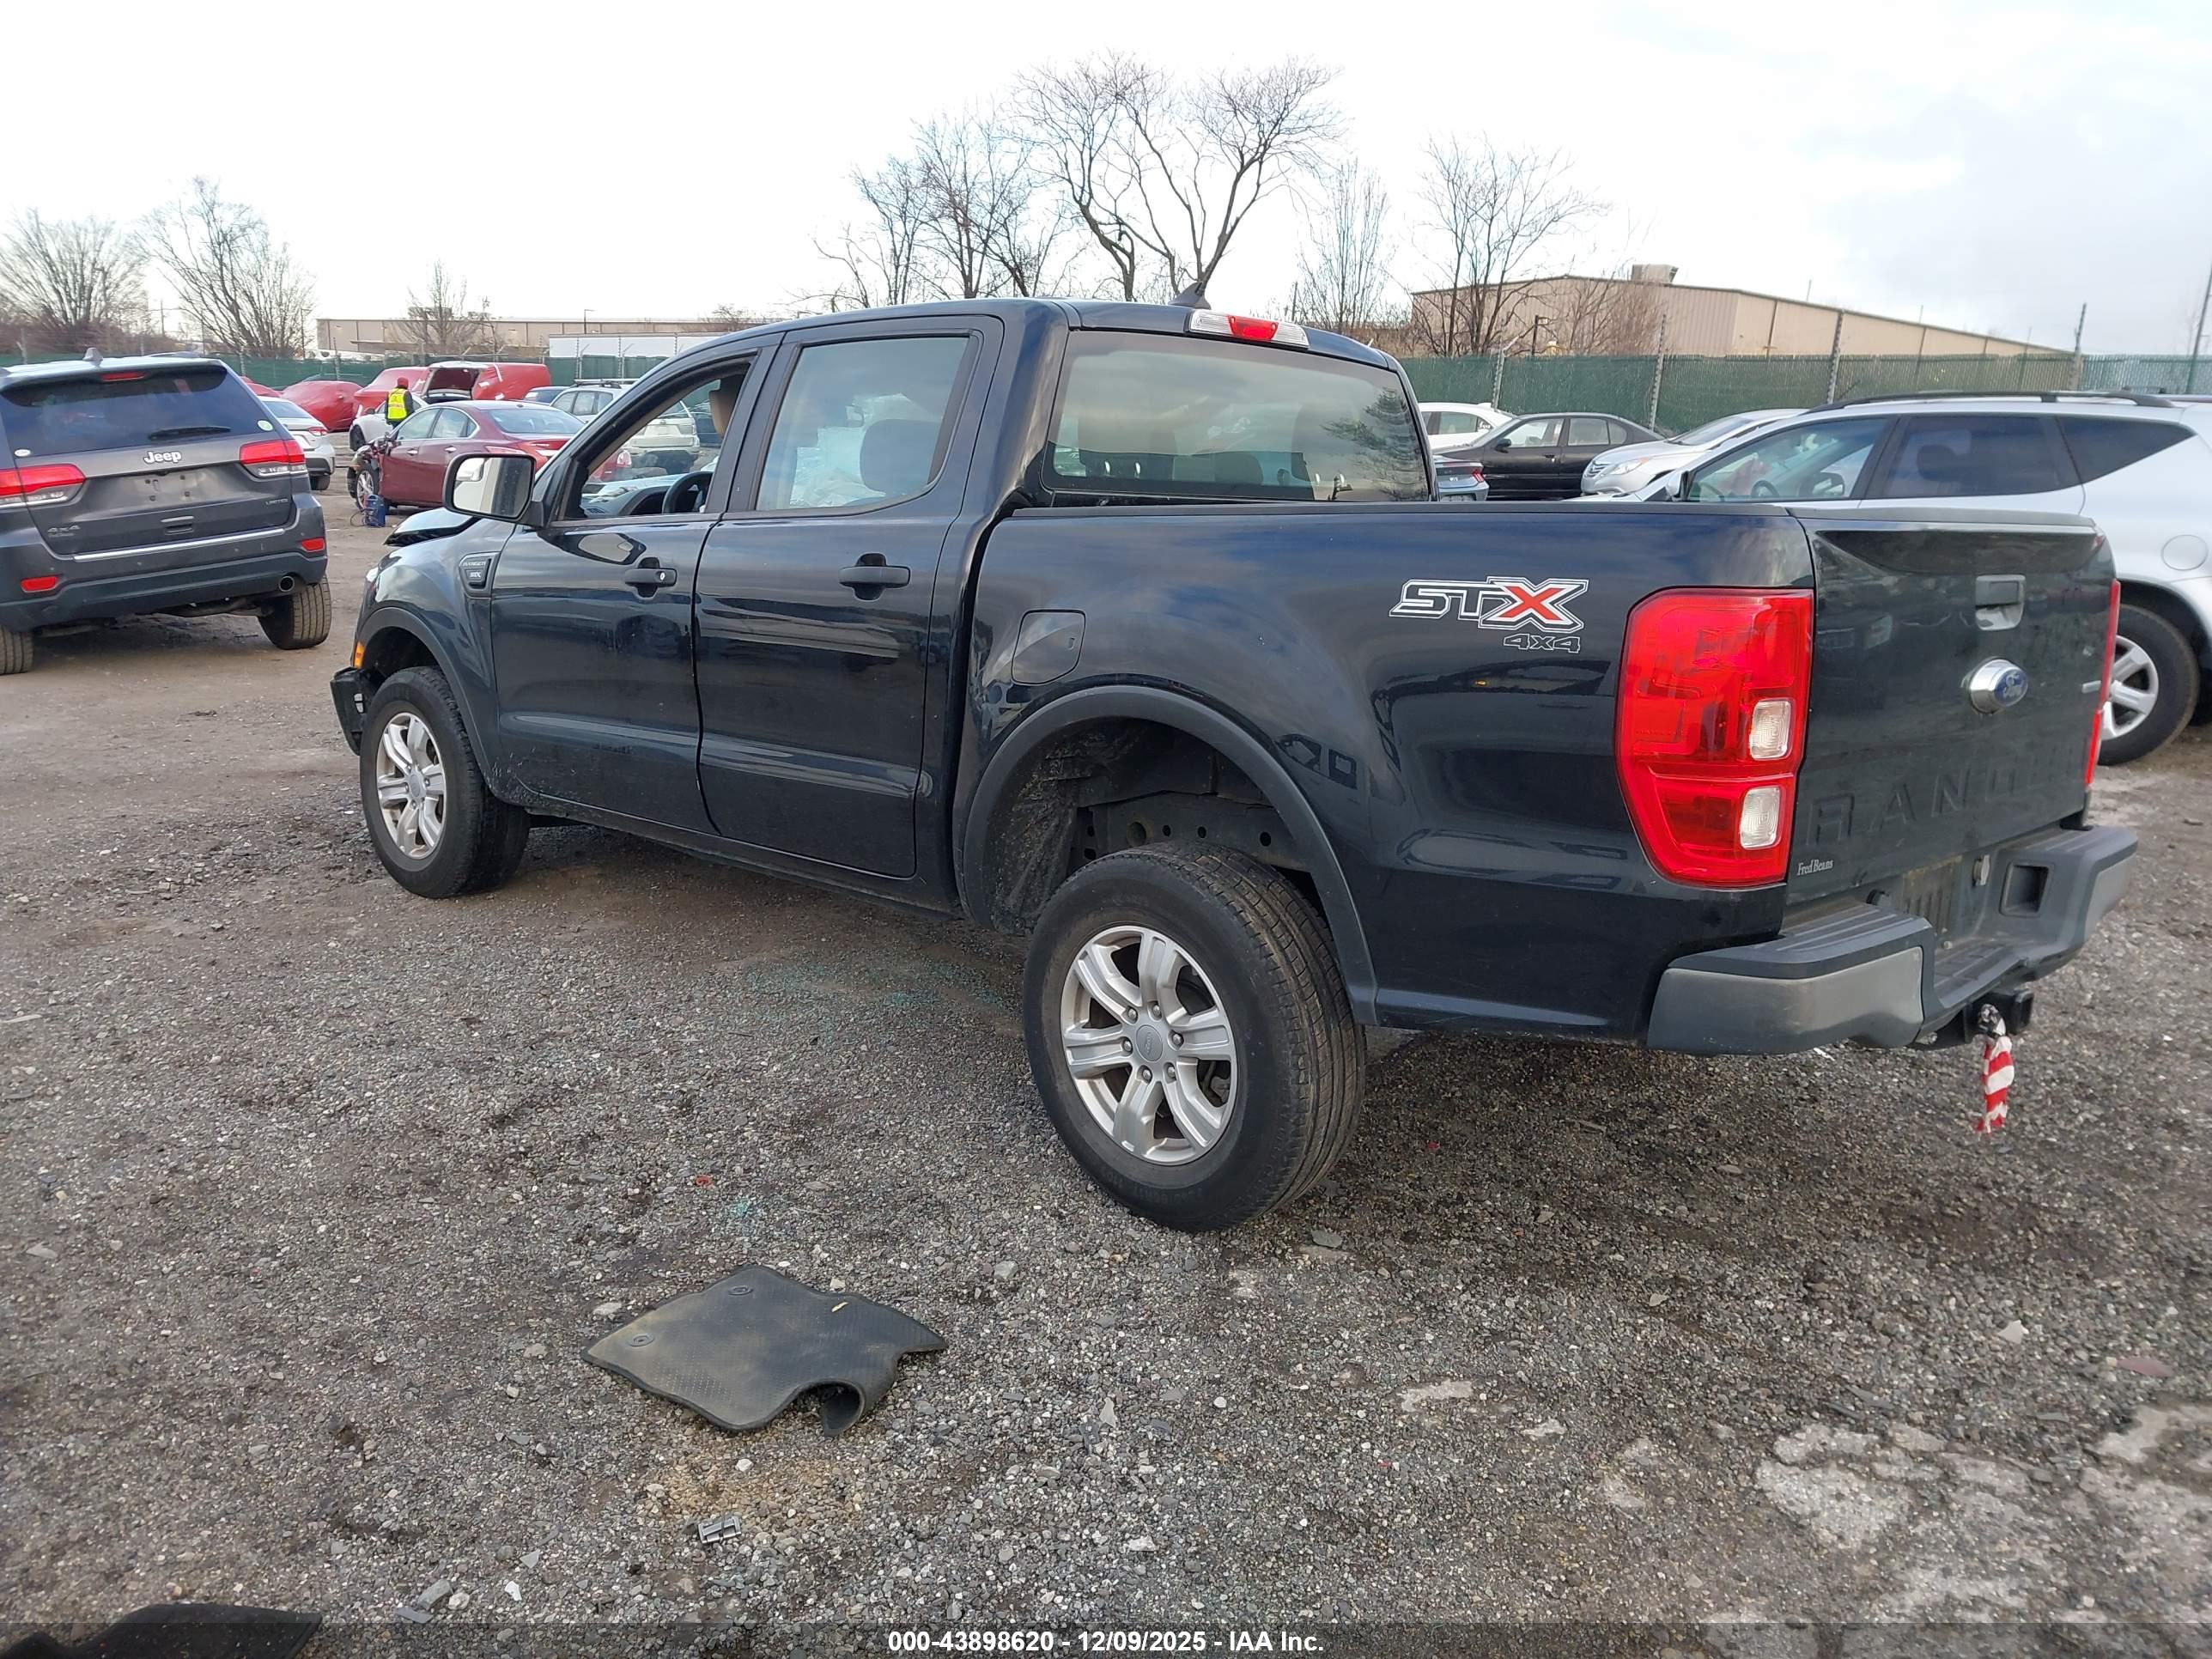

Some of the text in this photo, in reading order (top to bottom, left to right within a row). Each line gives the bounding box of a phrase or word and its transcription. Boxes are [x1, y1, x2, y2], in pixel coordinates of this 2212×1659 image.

[143, 452, 182, 464] Jeep
[1389, 576, 1589, 633] STX
[1796, 859, 1834, 876] Fred Beans
